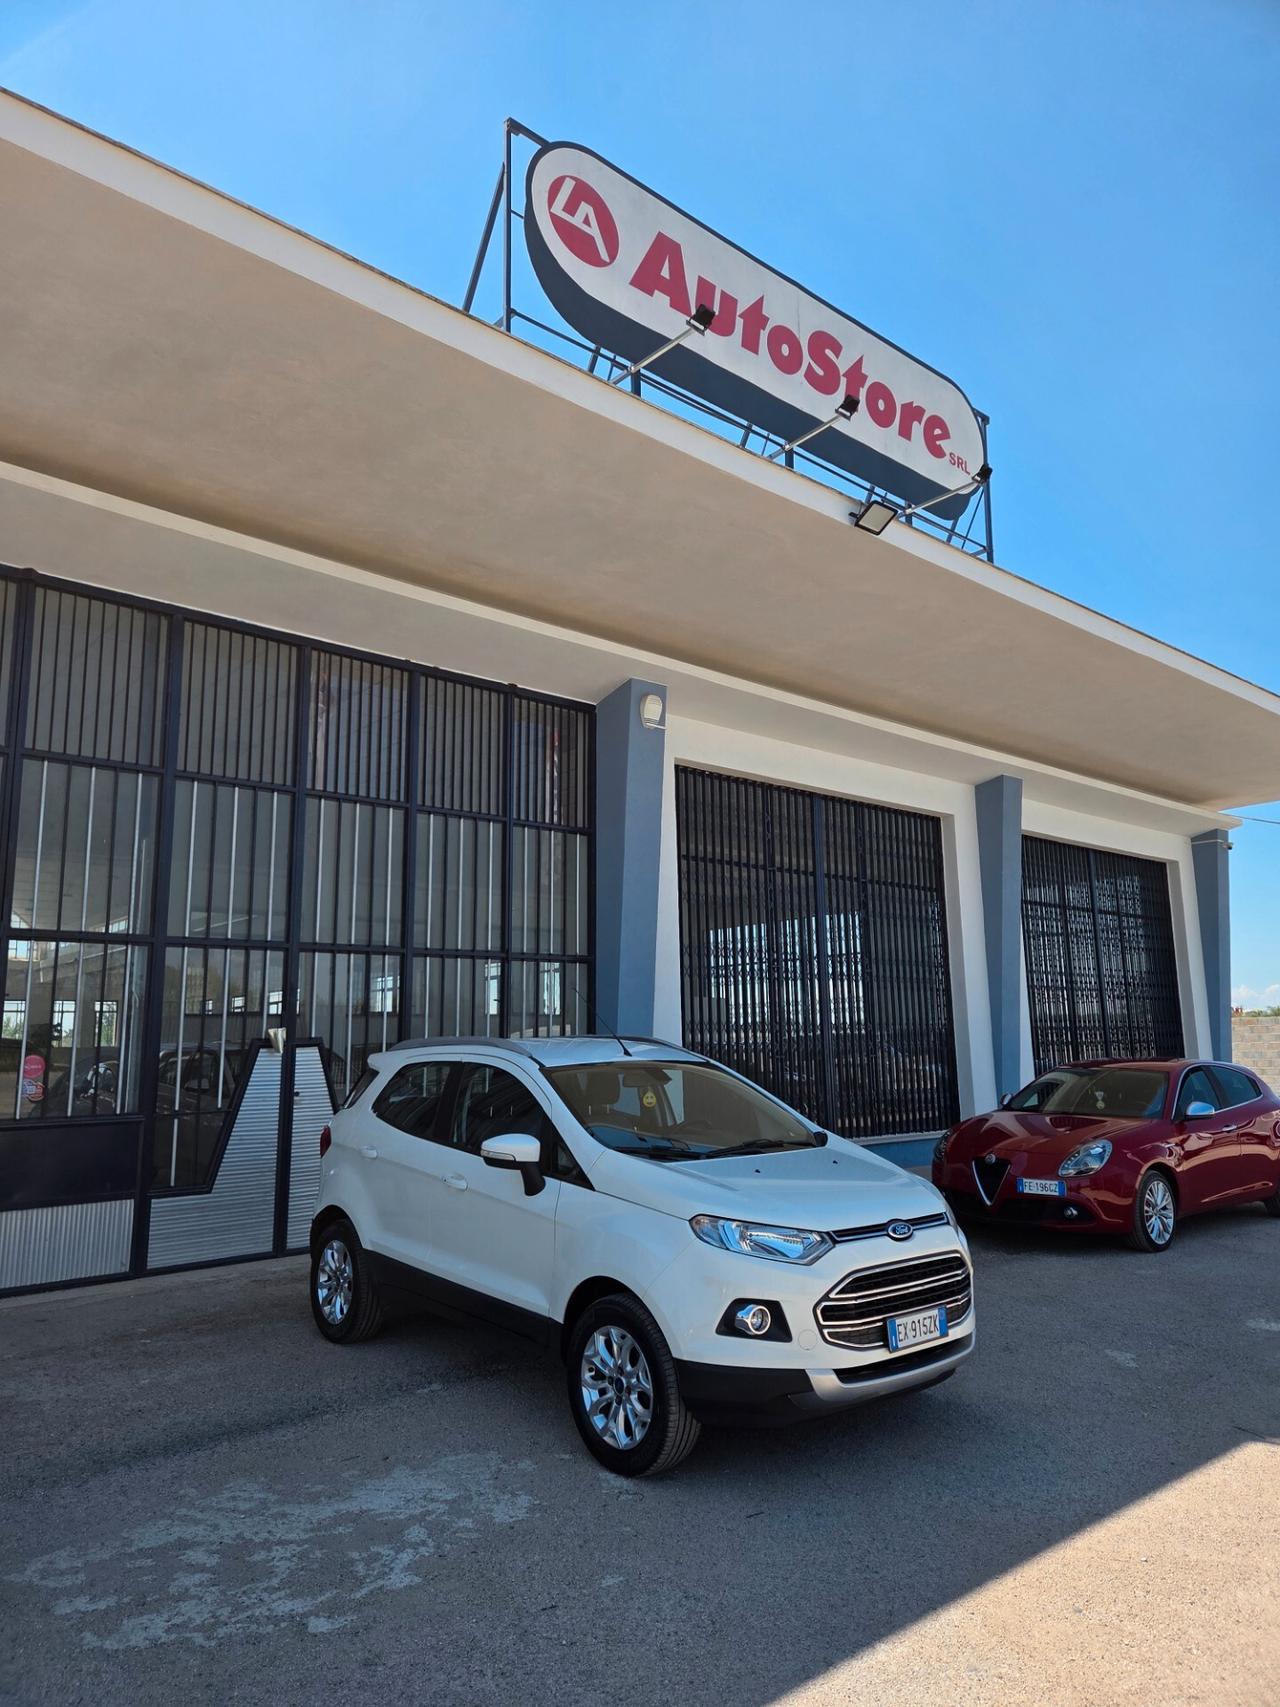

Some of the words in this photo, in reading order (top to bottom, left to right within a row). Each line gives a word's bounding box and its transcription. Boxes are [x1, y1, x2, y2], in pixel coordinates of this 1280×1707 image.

[629, 231, 951, 460] AutoStore
[949, 451, 971, 476] SRL
[911, 1314, 939, 1339] 915ZK
